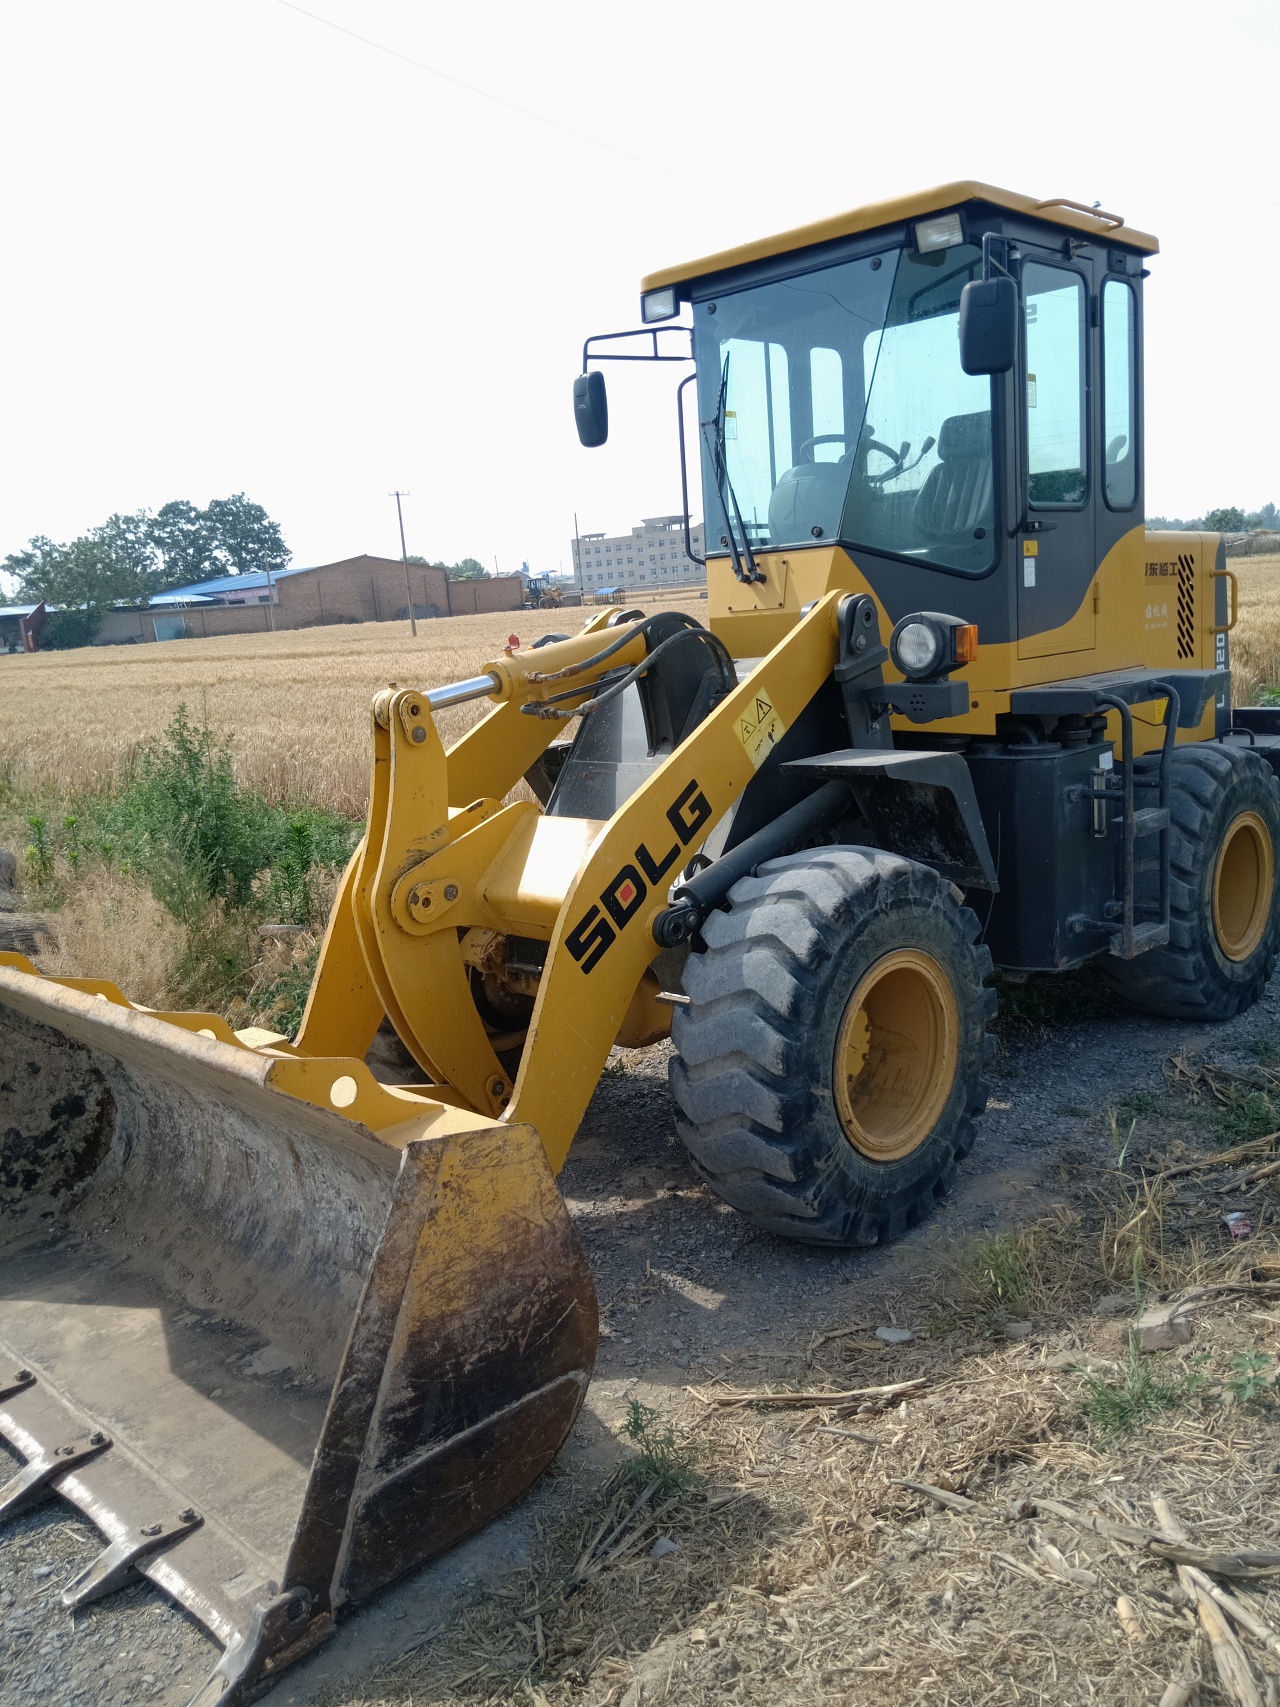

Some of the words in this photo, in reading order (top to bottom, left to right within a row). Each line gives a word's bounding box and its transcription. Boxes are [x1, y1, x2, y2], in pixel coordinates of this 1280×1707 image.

[1145, 562, 1178, 576] 东临工
[565, 778, 713, 975] SDLG
